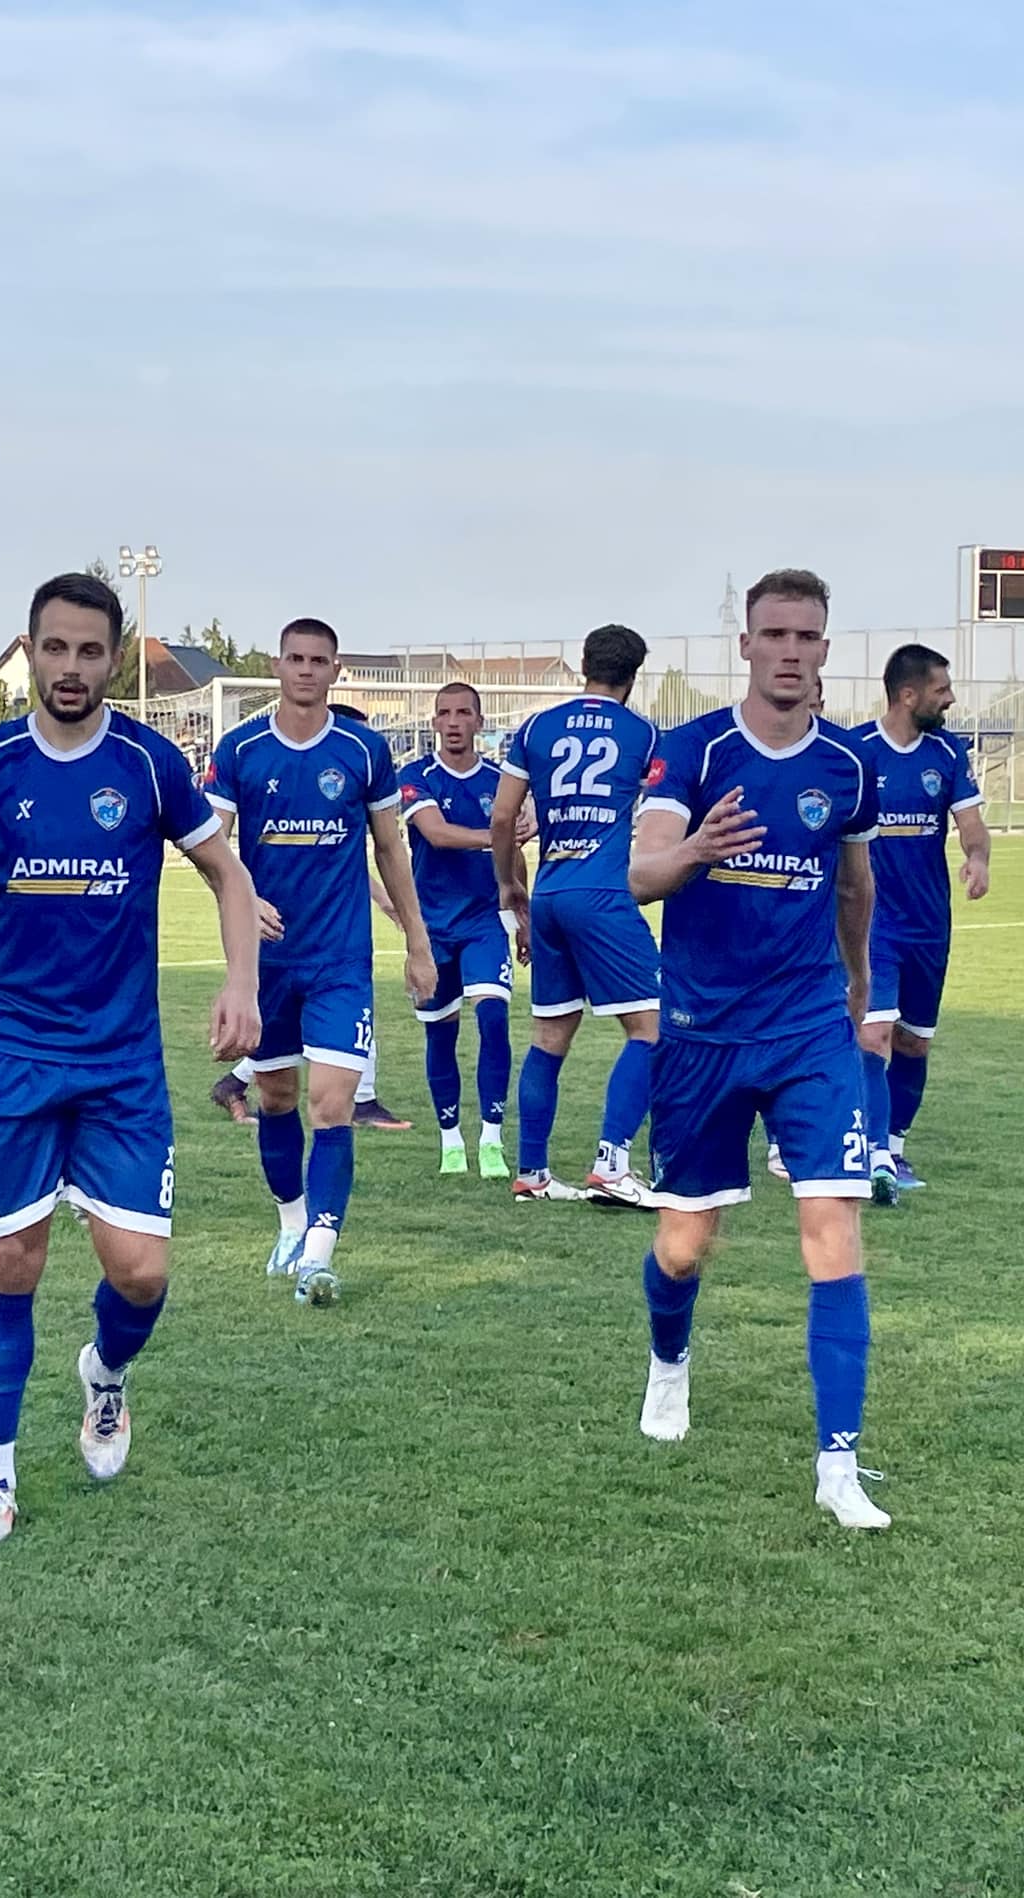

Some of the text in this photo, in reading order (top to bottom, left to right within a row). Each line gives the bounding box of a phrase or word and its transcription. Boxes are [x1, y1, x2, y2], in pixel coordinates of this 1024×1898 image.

[550, 735, 619, 797] 22
[262, 818, 348, 834] ADMIRAL
[11, 857, 129, 878] ADMIRAL
[87, 879, 130, 896] BET
[354, 1021, 372, 1051] 12
[159, 1169, 174, 1209] 8
